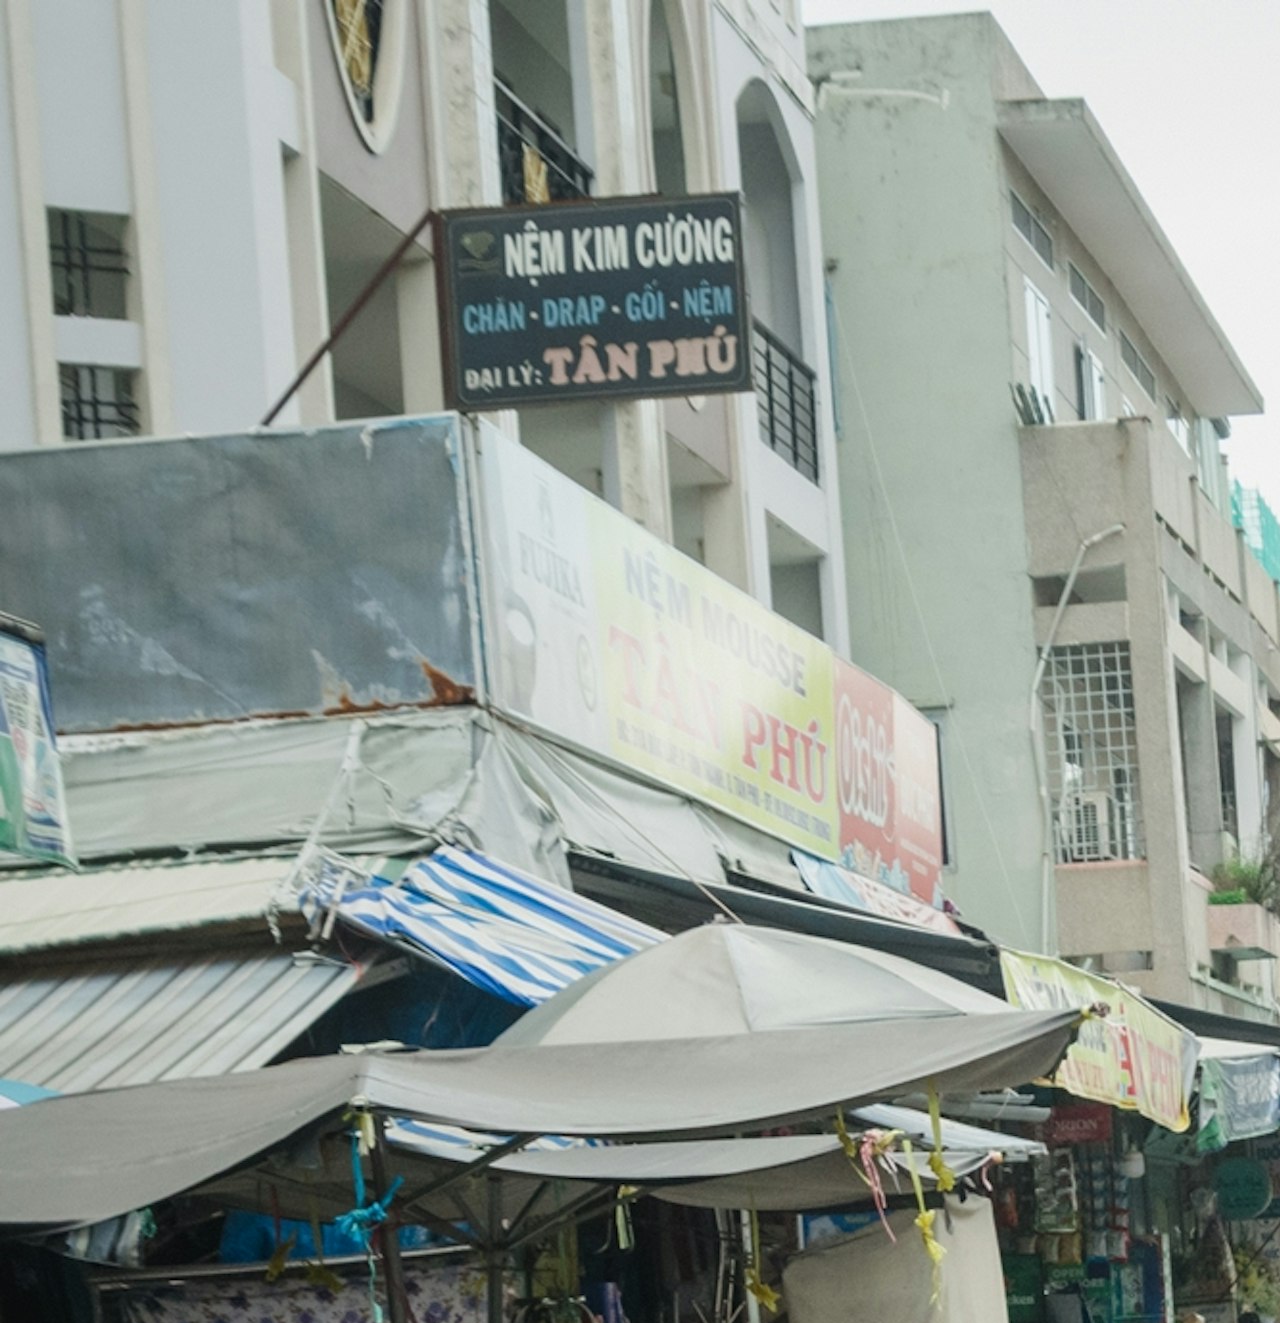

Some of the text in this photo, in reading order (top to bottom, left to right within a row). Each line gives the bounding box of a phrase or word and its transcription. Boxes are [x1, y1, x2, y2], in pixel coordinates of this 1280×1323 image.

[503, 219, 566, 287] NỆM
[571, 224, 629, 273] KIM
[542, 295, 606, 327] DRAP
[625, 279, 666, 322] GỐI
[683, 278, 733, 324] NỆM
[543, 334, 639, 386] TÂN
[647, 325, 738, 379] PHÚ
[701, 595, 807, 698] MOUSSE
[740, 719, 829, 804] PHÚ
